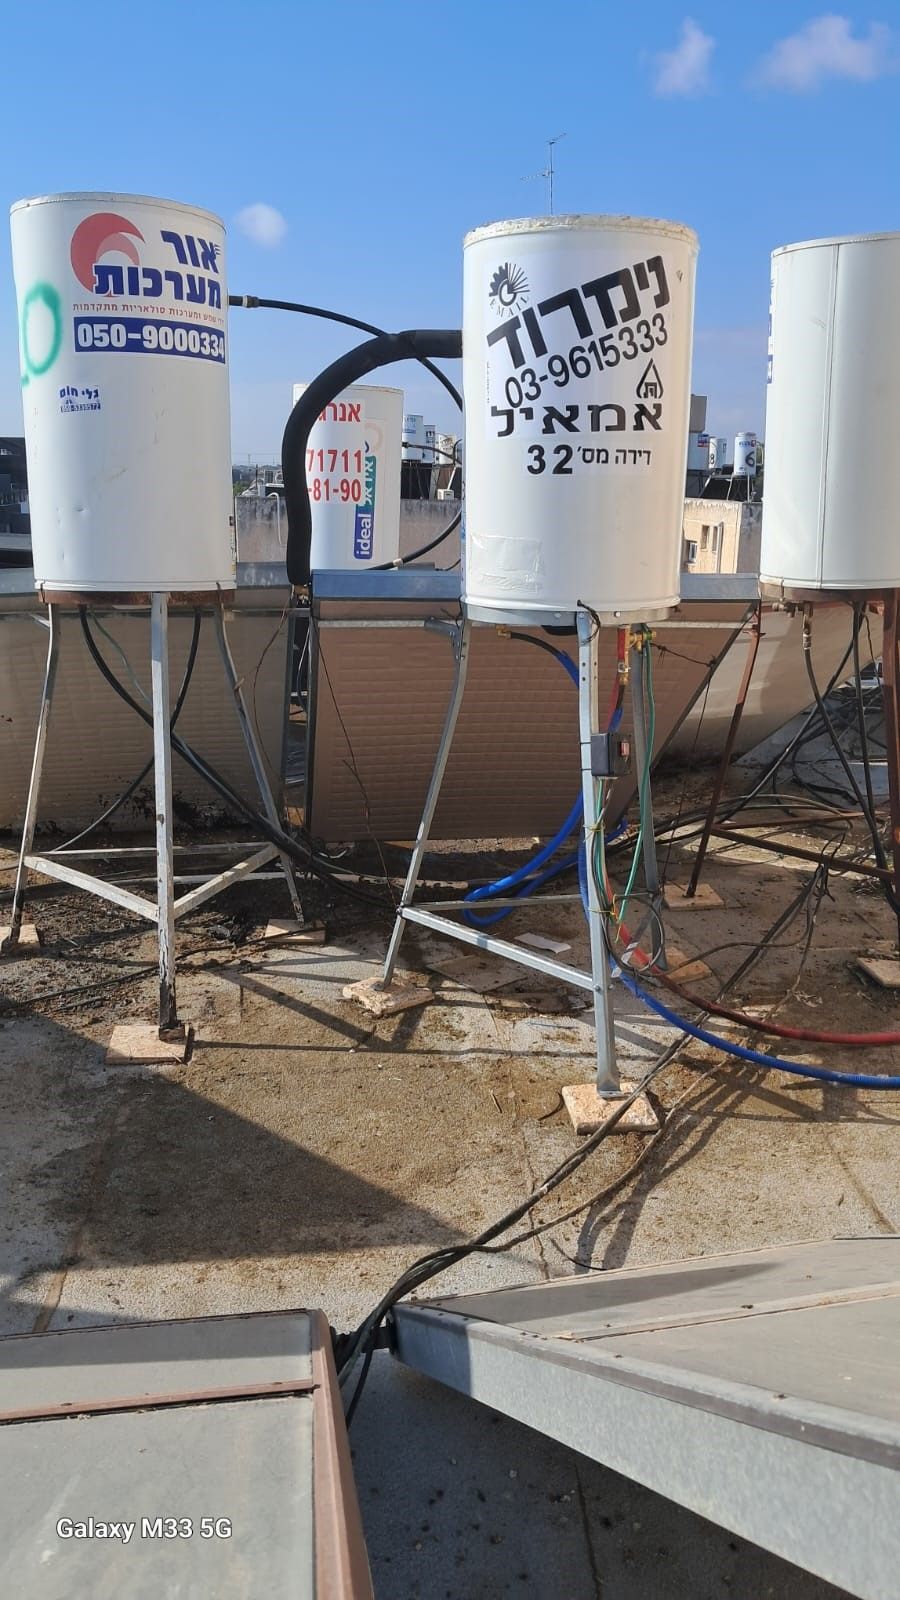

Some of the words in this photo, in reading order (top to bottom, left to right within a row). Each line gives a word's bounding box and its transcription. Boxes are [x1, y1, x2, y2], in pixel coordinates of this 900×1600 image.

[161, 230, 220, 274] אור
[93, 264, 221, 309] מערכות
[72, 303, 118, 311] מתקדמות
[121, 304, 166, 314] סולאריות
[169, 307, 201, 320] ומערכות
[486, 255, 670, 370] נימרוד
[77, 323, 225, 358] 050-9000334
[505, 313, 668, 409] 03-9615333
[59, 385, 78, 398] חום
[82, 388, 99, 399] גלי
[491, 402, 663, 437] אמאיל
[307, 449, 362, 473] 71711
[527, 444, 573, 475] 32
[577, 446, 609, 465] מס'
[615, 449, 652, 466] דירה
[745, 451, 755, 468] 6
[356, 513, 372, 555] ideal
